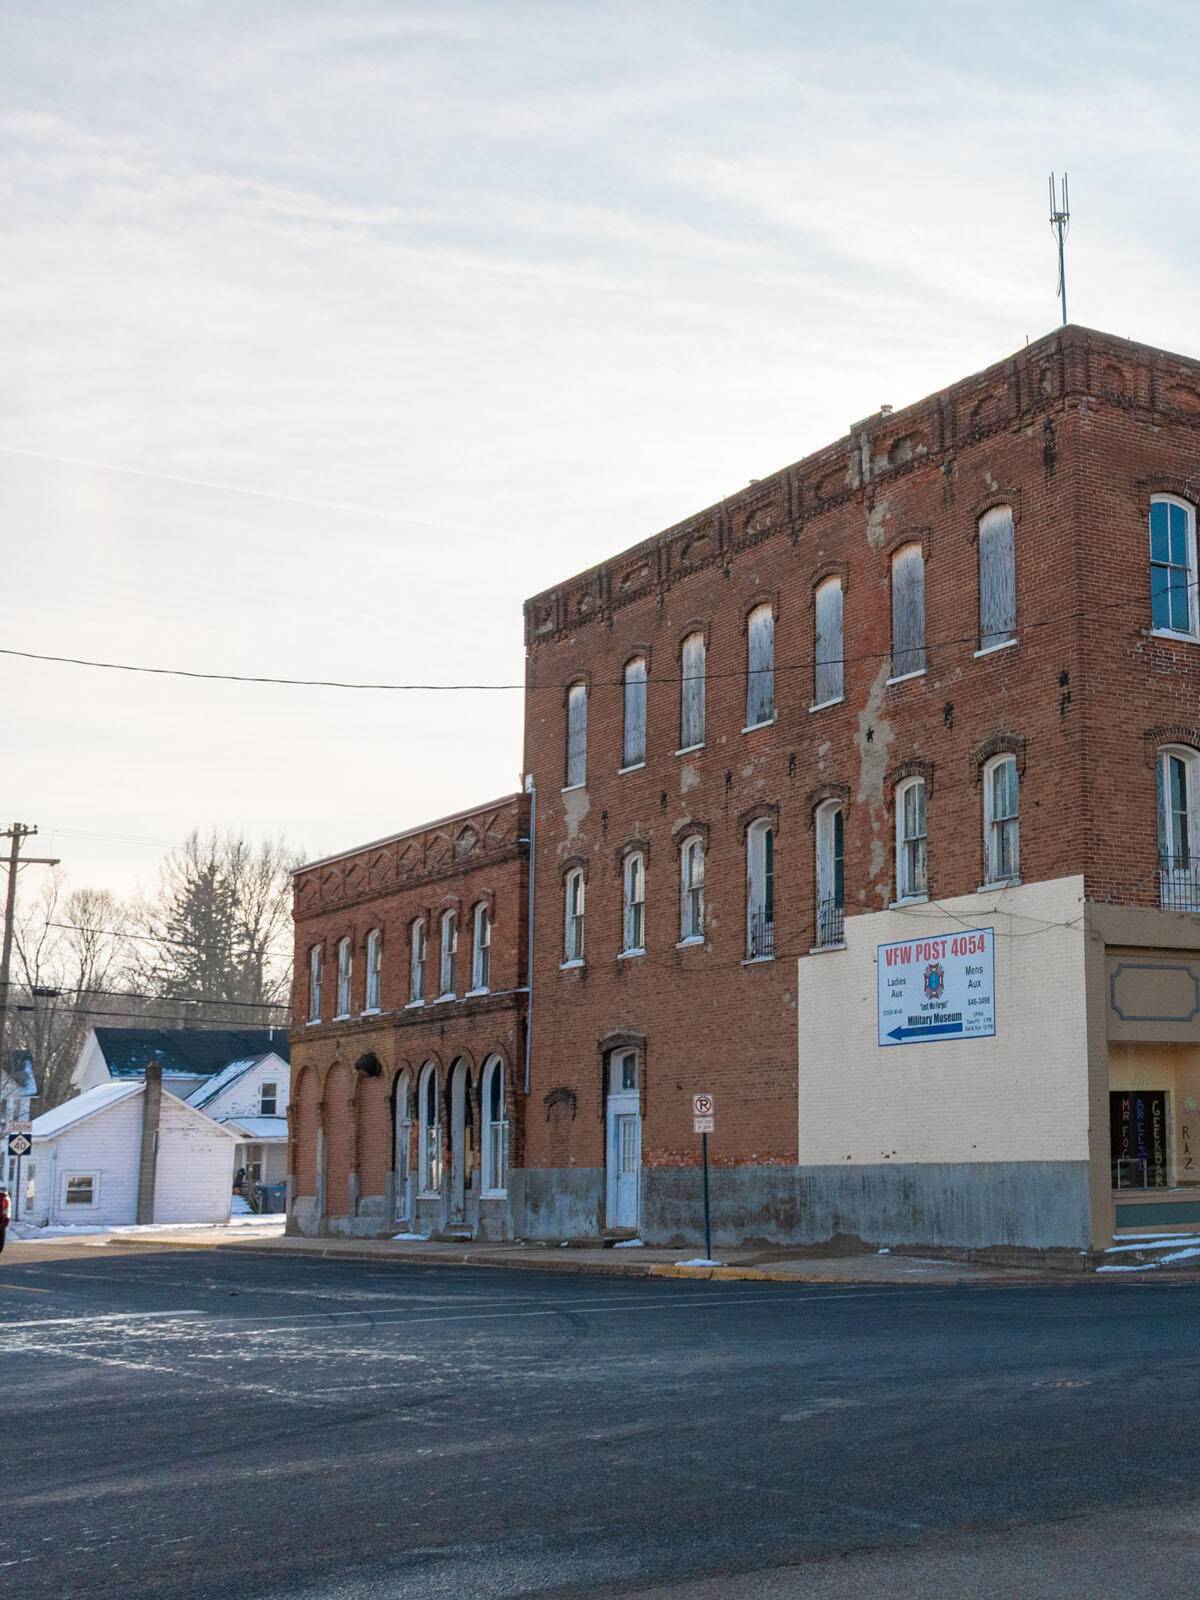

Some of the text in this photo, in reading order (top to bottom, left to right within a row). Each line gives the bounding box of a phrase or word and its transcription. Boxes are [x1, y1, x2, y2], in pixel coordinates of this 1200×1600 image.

[885, 933, 986, 967] VFW POST 4054
[965, 965, 983, 976] Mens
[887, 977, 906, 987] Ladies
[967, 979, 981, 989] Aux
[891, 989, 903, 999] Aux
[907, 1012, 963, 1027] Military Museum
[13, 1142, 27, 1150] 40
[1182, 1126, 1194, 1170] RAZ
